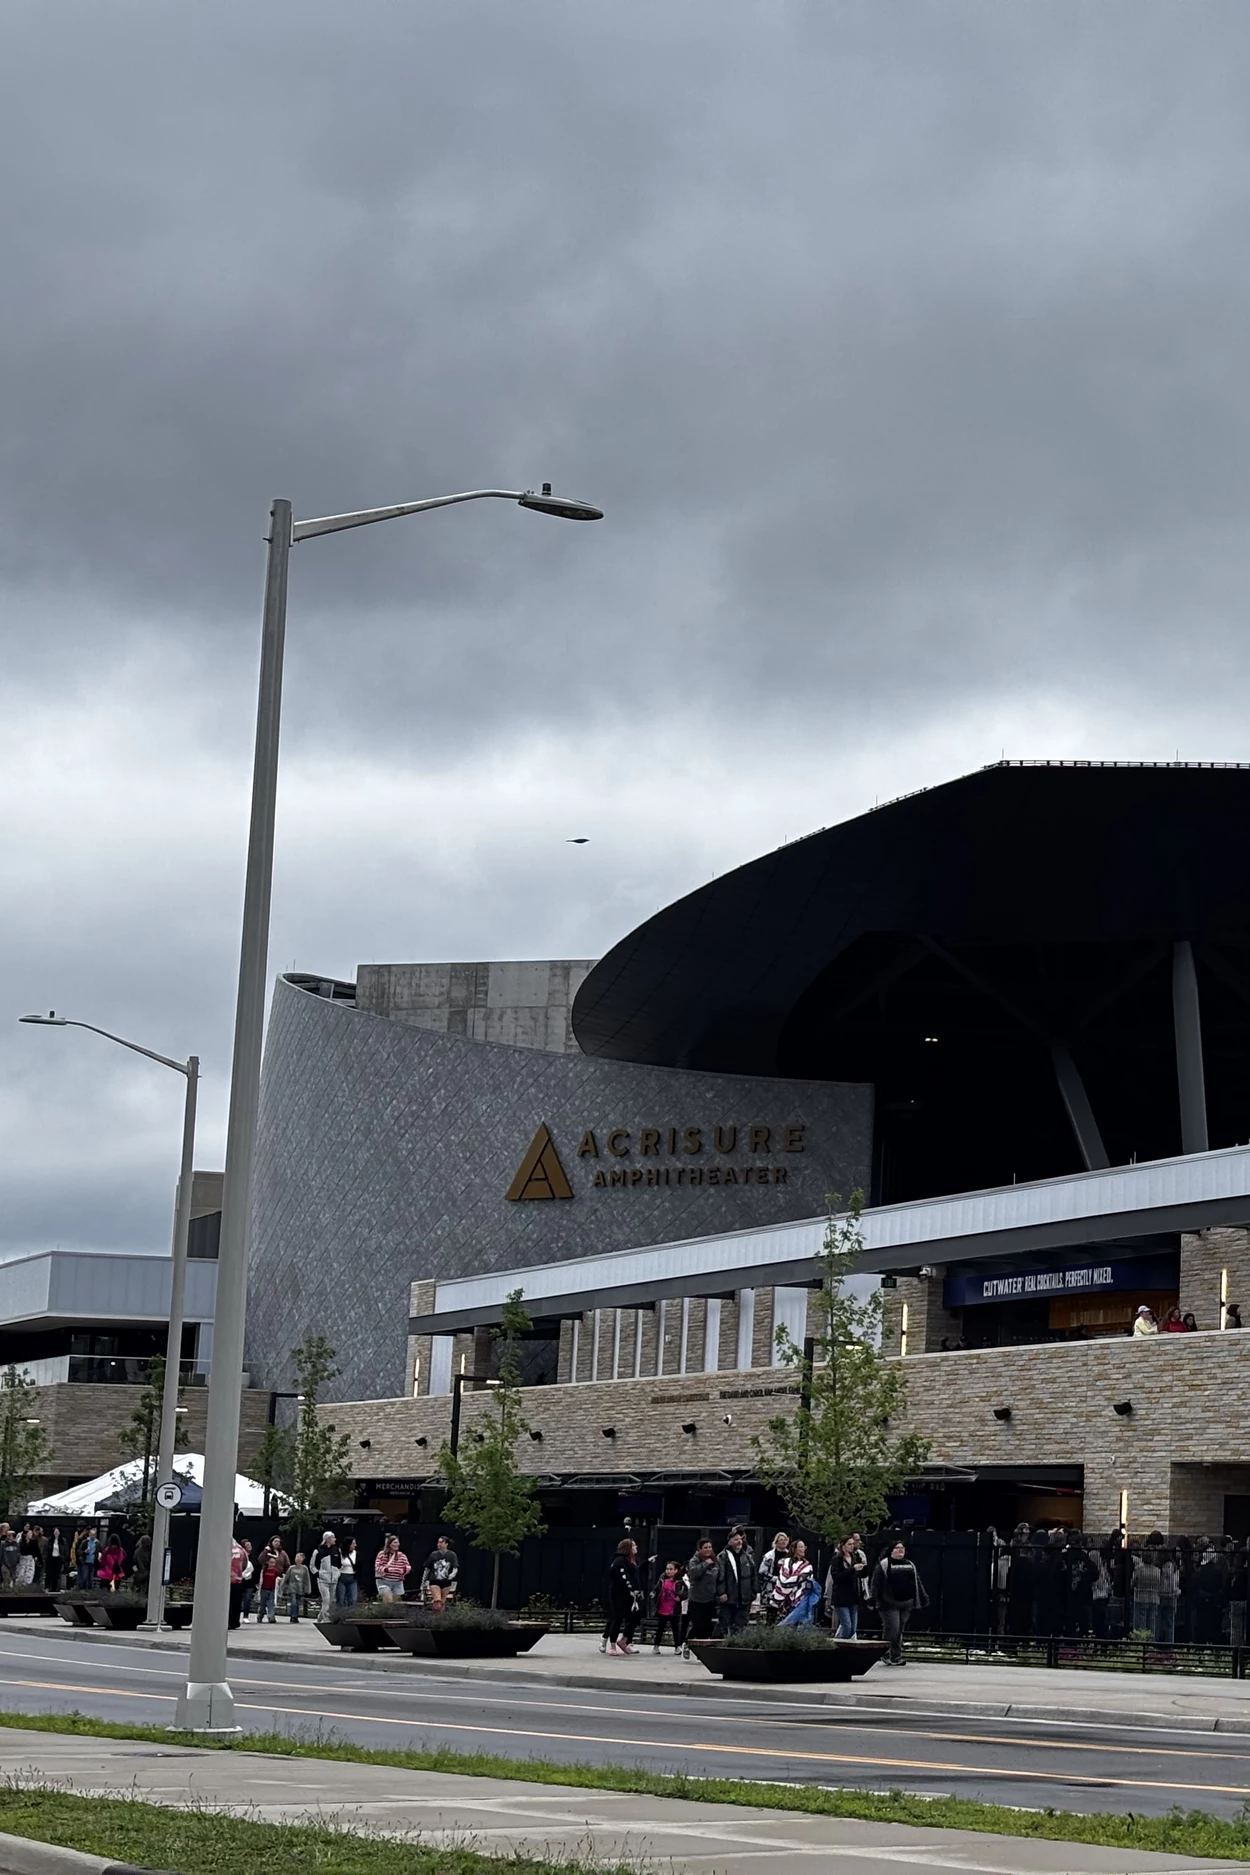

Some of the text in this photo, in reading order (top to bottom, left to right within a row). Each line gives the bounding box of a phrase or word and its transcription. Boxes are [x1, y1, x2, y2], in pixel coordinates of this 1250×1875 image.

[577, 1125, 806, 1158] ACRISURE
[592, 1166, 789, 1188] AMPHITHEATER
[1065, 1268, 1093, 1288] PERFECTLY
[1093, 1266, 1113, 1284] MIXED.
